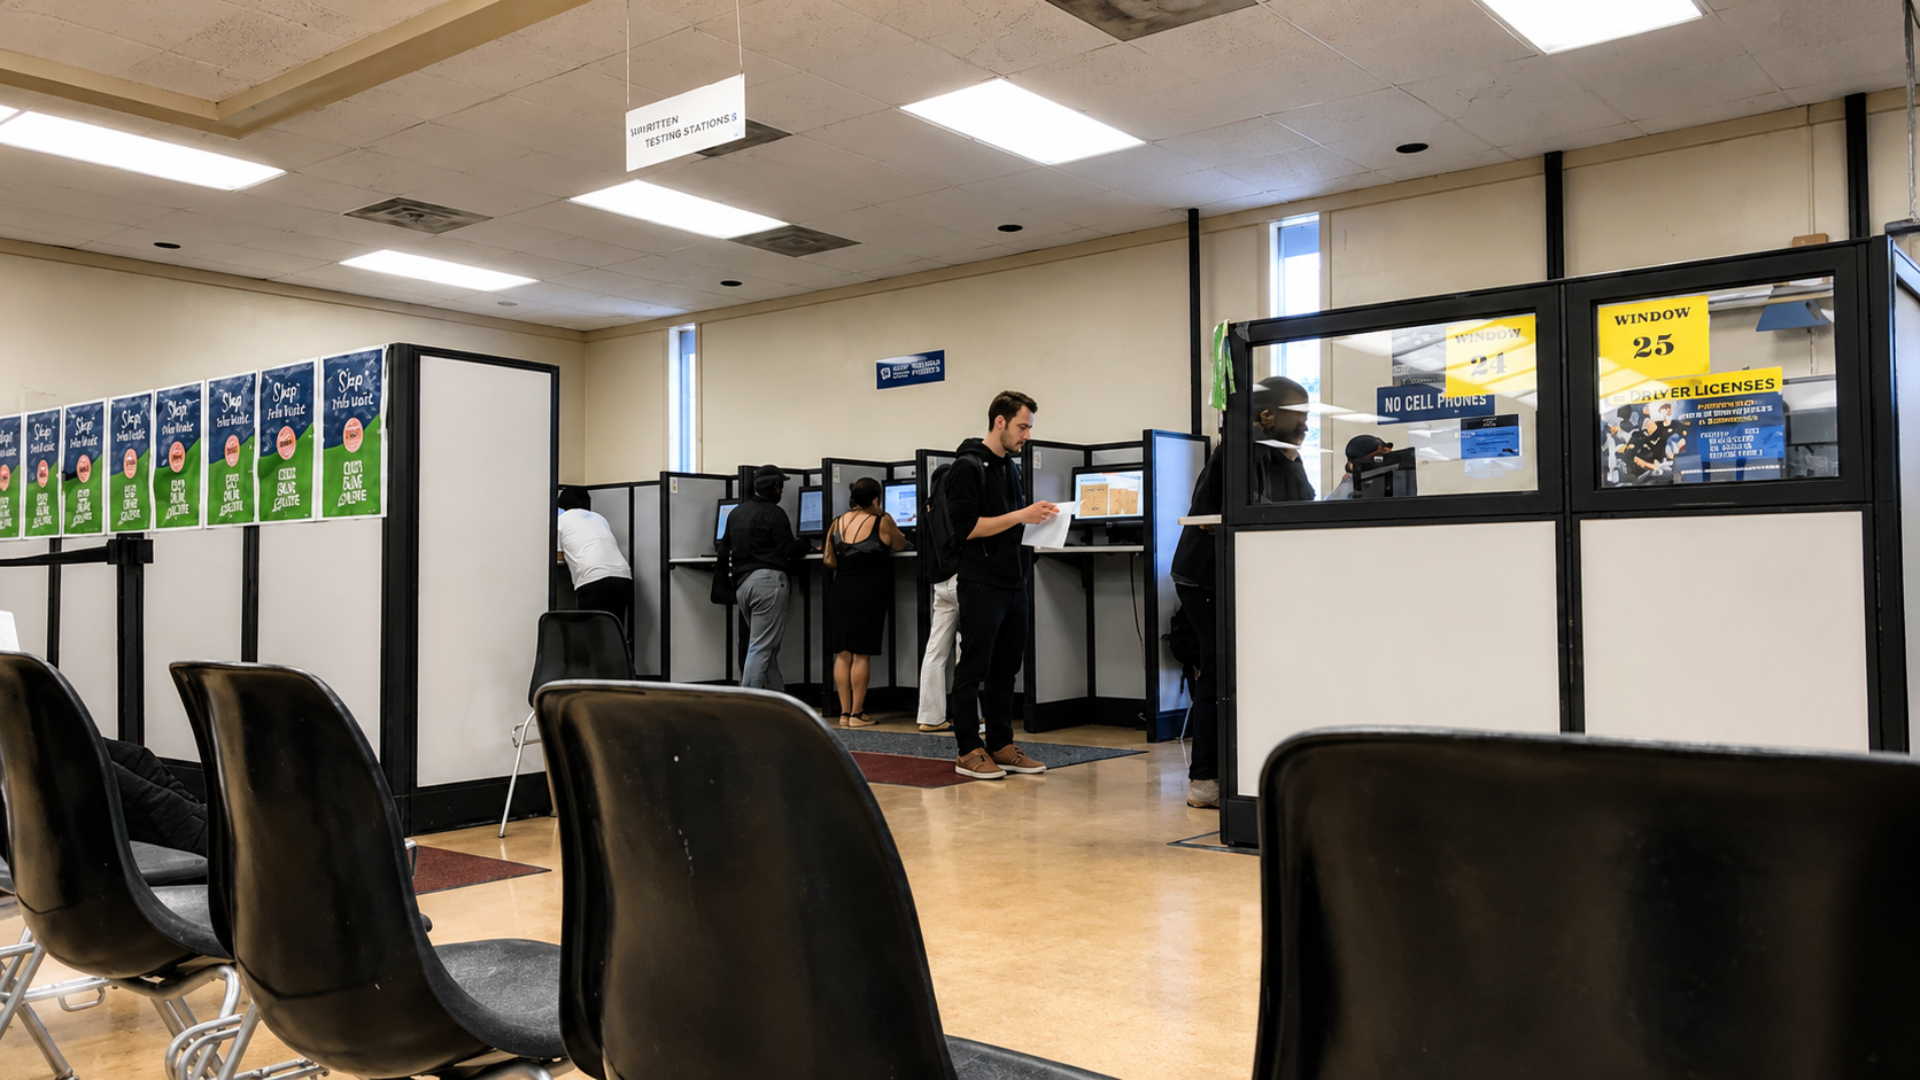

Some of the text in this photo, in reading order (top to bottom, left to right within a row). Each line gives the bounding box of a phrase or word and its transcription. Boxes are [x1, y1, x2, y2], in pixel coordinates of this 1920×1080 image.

[645, 129, 682, 148] TESTING
[683, 114, 730, 136] STATIONS
[1614, 306, 1691, 326] WINDOW
[1454, 328, 1522, 344] WINDOW
[1633, 333, 1675, 359] 25
[1471, 352, 1507, 377] 24
[1694, 377, 1775, 397] LICENSES
[1384, 393, 1487, 413] NO CELL PHONES
